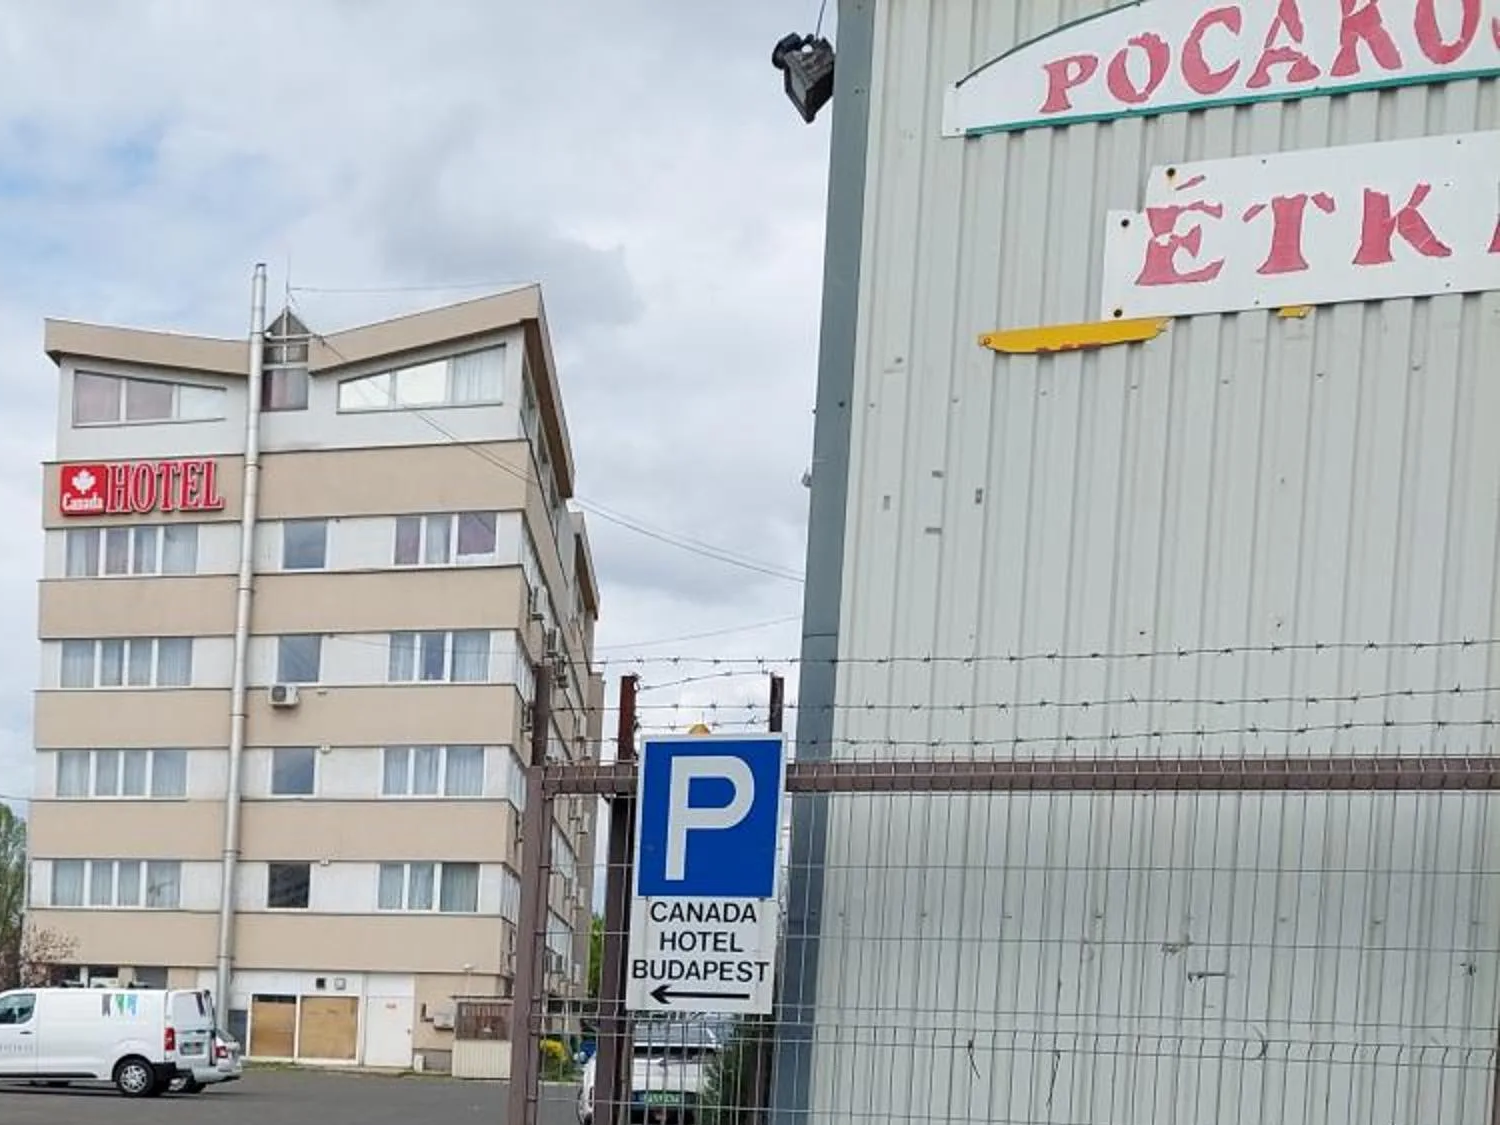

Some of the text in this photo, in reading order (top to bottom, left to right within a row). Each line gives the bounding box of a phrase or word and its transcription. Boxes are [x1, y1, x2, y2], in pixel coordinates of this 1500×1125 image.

[1040, 0, 1500, 113] POCAKO
[1135, 174, 1500, 286] ÉTK
[105, 460, 224, 513] HOTEL
[665, 755, 755, 881] P
[650, 901, 757, 923] CANADA
[659, 930, 744, 953] HOTEL
[632, 959, 770, 983] BUDAPEST
